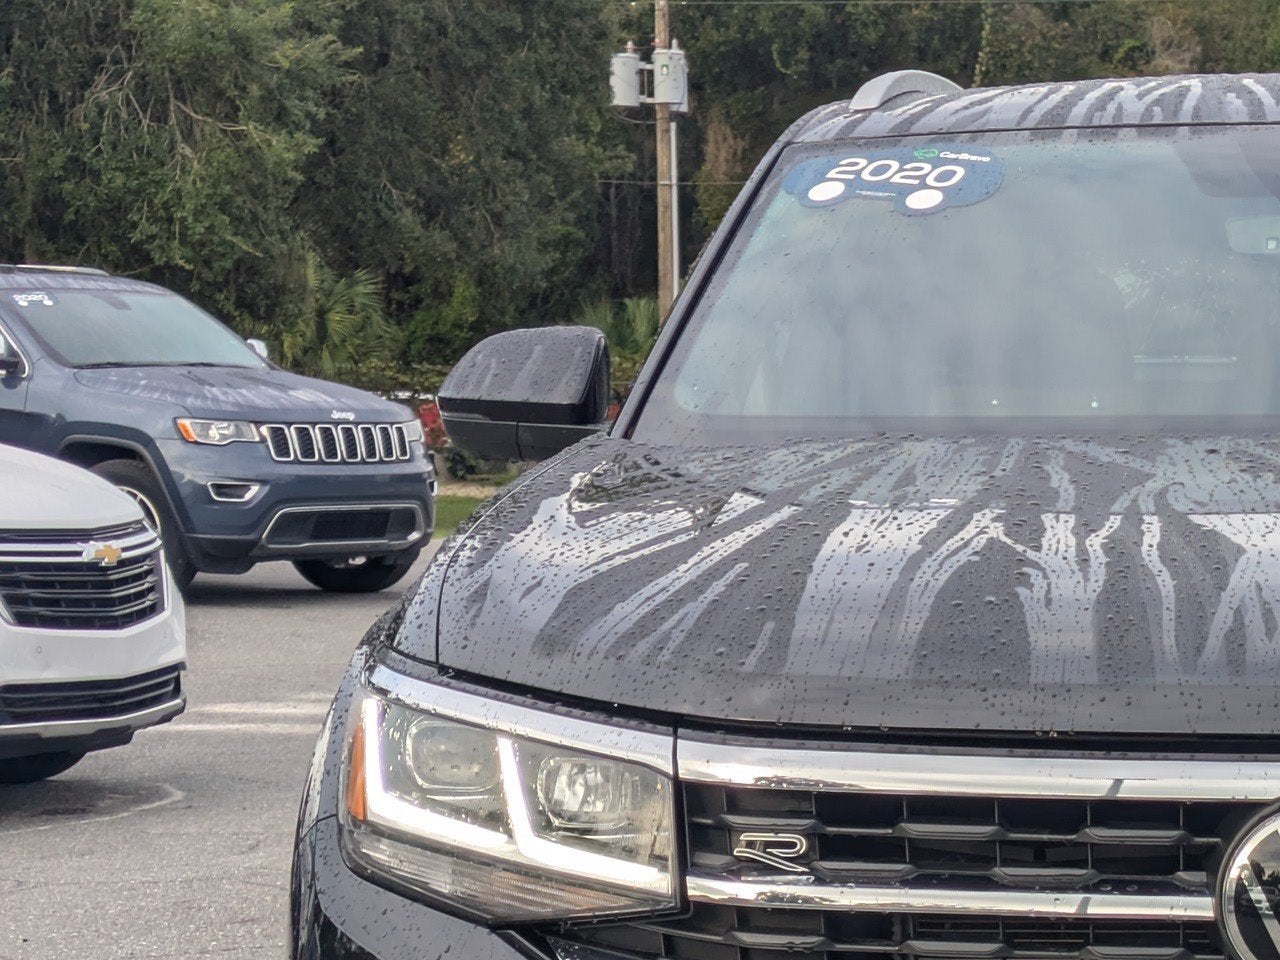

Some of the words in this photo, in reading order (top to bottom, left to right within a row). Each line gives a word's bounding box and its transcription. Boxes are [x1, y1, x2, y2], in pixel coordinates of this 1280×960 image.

[825, 157, 966, 188] 2020
[331, 409, 356, 421] Jeep
[733, 832, 810, 872] R
